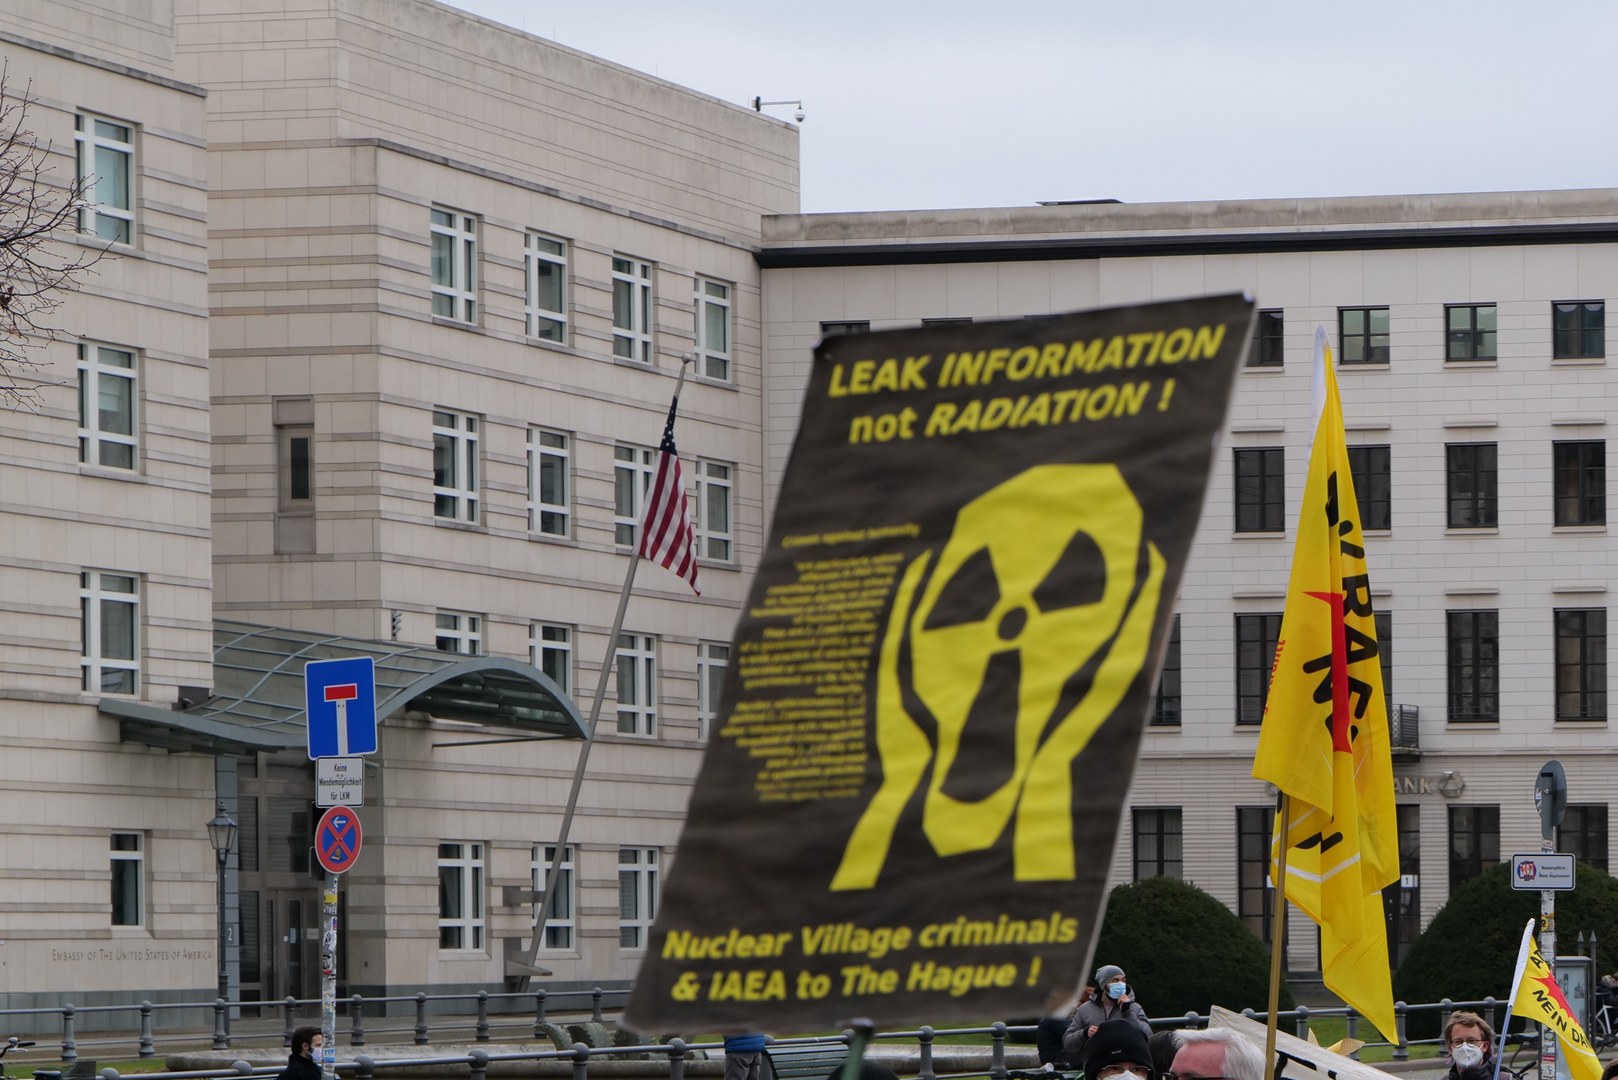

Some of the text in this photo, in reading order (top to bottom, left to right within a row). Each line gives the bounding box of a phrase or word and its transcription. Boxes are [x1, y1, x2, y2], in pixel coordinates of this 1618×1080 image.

[826, 324, 1226, 399] LEAK INFORMATION
[849, 379, 1175, 444] not RADIATION !
[1394, 776, 1432, 794] ANK
[52, 949, 84, 961] EMBASSY
[116, 949, 143, 961] UNITED
[145, 949, 169, 961] STATES
[182, 949, 212, 960] AMERICA
[228, 928, 233, 941] 2
[661, 911, 1078, 962] Nuclear Village criminals
[670, 957, 1041, 1002] & IAEA to The Hague !
[1532, 989, 1568, 1032] NEIN
